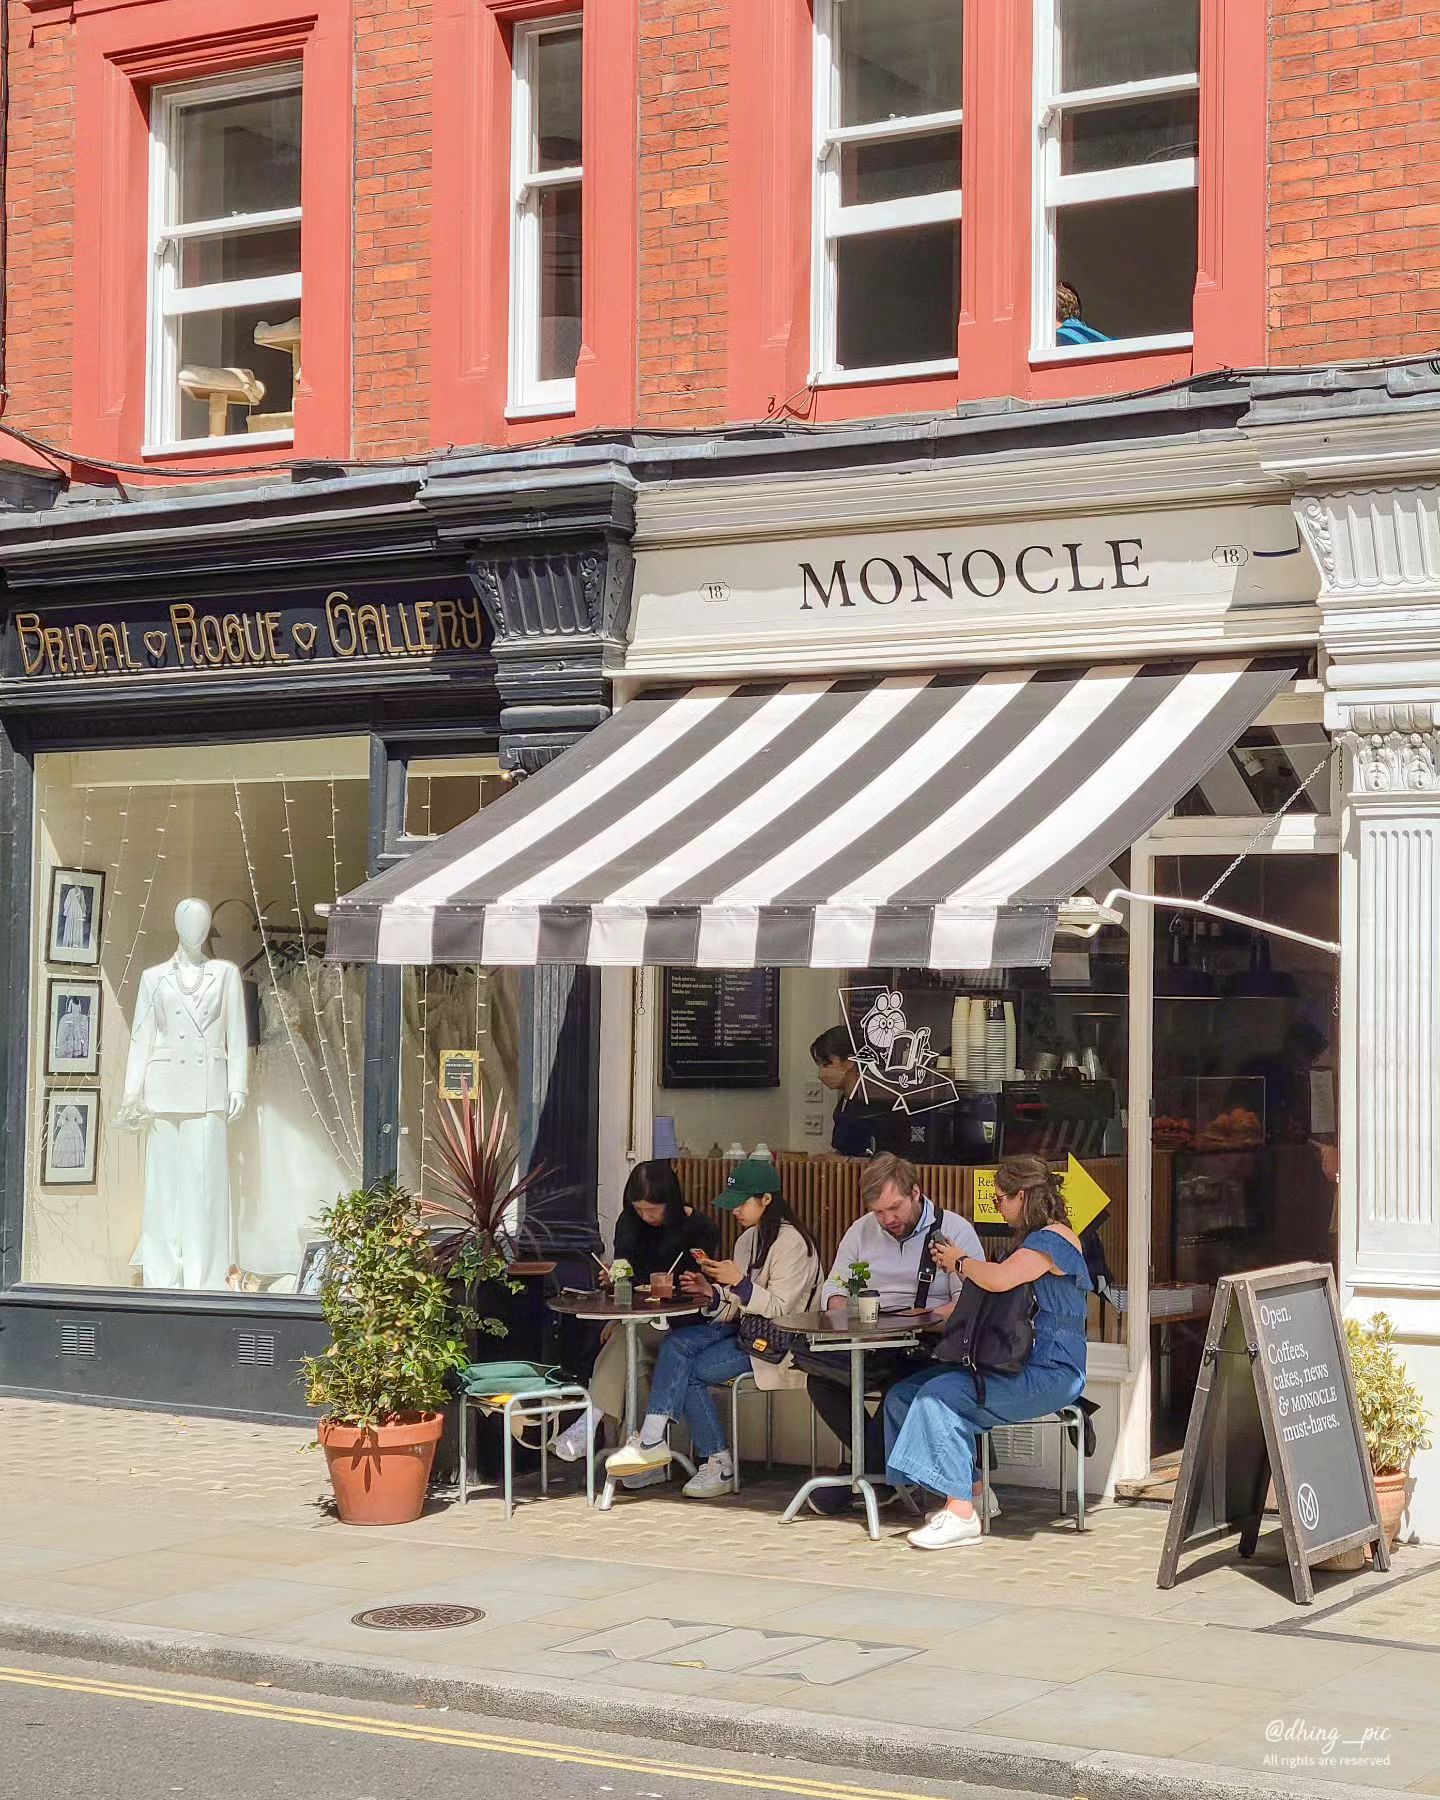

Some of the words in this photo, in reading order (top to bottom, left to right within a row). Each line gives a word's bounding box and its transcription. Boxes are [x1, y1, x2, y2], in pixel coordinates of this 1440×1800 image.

[1223, 548, 1240, 564] 18
[799, 538, 1149, 609] MONOCLE
[708, 585, 723, 599] 18
[15, 612, 142, 674] BRIDAL
[168, 603, 290, 666] ROGUE
[325, 591, 483, 657] GALLERY
[1260, 1305, 1292, 1330] Open.
[1267, 1340, 1309, 1365] Coffees,
[1273, 1367, 1304, 1391] cakes,
[1303, 1363, 1329, 1383] news
[1278, 1395, 1290, 1417] &
[1290, 1385, 1338, 1413] MONOCLE
[1282, 1413, 1341, 1443] must-haves.
